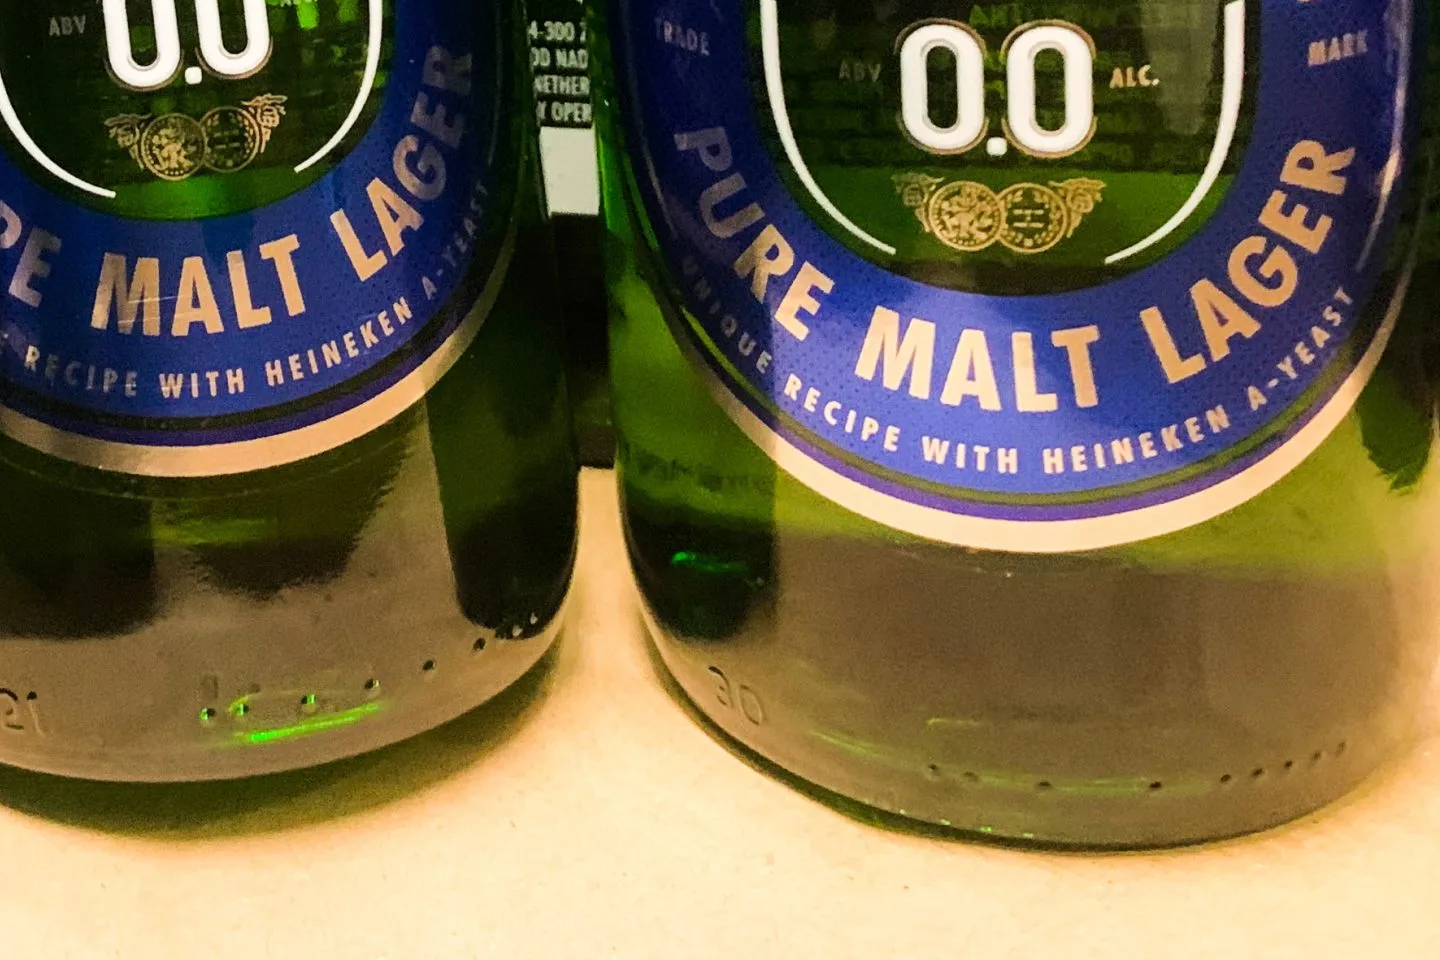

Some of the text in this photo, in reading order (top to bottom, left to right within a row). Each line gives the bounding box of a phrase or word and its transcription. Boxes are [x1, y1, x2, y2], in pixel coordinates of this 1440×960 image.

[48, 15, 87, 37] ABV
[898, 20, 1097, 159] 0.0
[1109, 64, 1160, 90] ALC.
[1308, 29, 1370, 67] MARK
[90, 233, 306, 338] MALT
[330, 44, 473, 283] LAGER
[674, 125, 1356, 413] PURE MALT LAGER
[23, 343, 137, 398] RECIPE
[158, 366, 246, 400] WITH
[265, 296, 412, 387] HEINEKEN
[681, 259, 1355, 475] UNIQUE RECIPE WITH HEINEKEN A-YEAST
